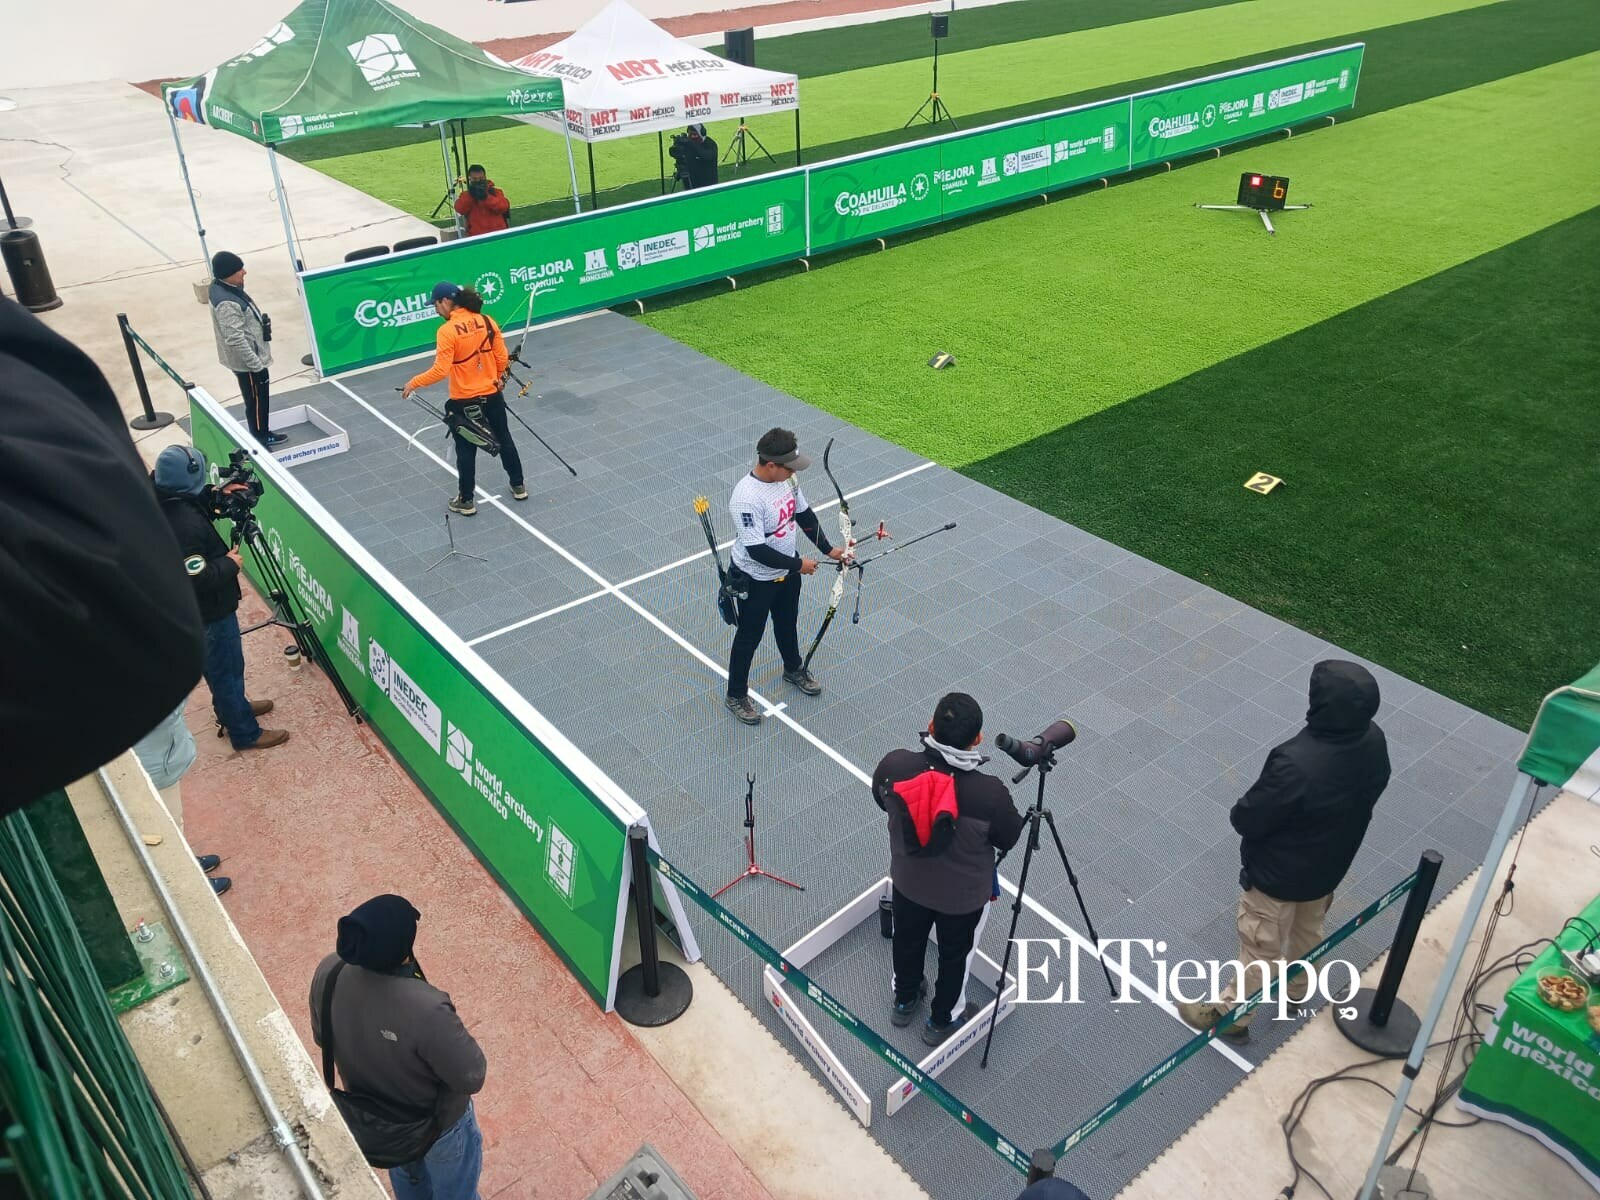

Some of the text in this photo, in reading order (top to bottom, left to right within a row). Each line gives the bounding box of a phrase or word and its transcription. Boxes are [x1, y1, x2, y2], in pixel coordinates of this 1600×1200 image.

[517, 52, 592, 80] NRT MÉXICO
[606, 59, 664, 81] NRT
[665, 59, 724, 73] MÉXICO
[720, 92, 740, 105] NRT
[770, 82, 794, 97] NRT
[684, 92, 710, 109] NRT
[771, 97, 796, 106] MÉXICO
[591, 109, 618, 127] NRT
[630, 107, 651, 120] NRT
[685, 107, 711, 119] MÉXICO
[306, 122, 334, 132] mexico
[1149, 112, 1199, 137] COAHUILA
[1021, 150, 1044, 161] INEDEC
[934, 165, 975, 184] MEJORA
[835, 182, 906, 215] COAHUILA
[717, 217, 764, 235] world archery
[643, 238, 676, 252] INEDEC
[717, 231, 741, 243] mexico
[510, 258, 574, 284] MEJORA
[354, 291, 438, 328] COAHU
[416, 310, 437, 320] DELA
[934, 354, 949, 368] 1
[278, 454, 292, 463] orld
[317, 442, 340, 453] mexico
[1248, 475, 1274, 492] 2
[289, 547, 334, 617] MEJORA
[393, 671, 427, 718] INEDEC
[474, 774, 508, 820] mexico
[475, 758, 543, 844] world archery
[720, 912, 750, 940] ARCHERY
[946, 1028, 978, 1059] archery
[980, 1003, 1008, 1031] meco
[1512, 1021, 1595, 1077] world
[885, 1048, 923, 1083] ARCHERY
[1142, 1056, 1177, 1088] ARCHERY
[1503, 1037, 1600, 1101] mexico
